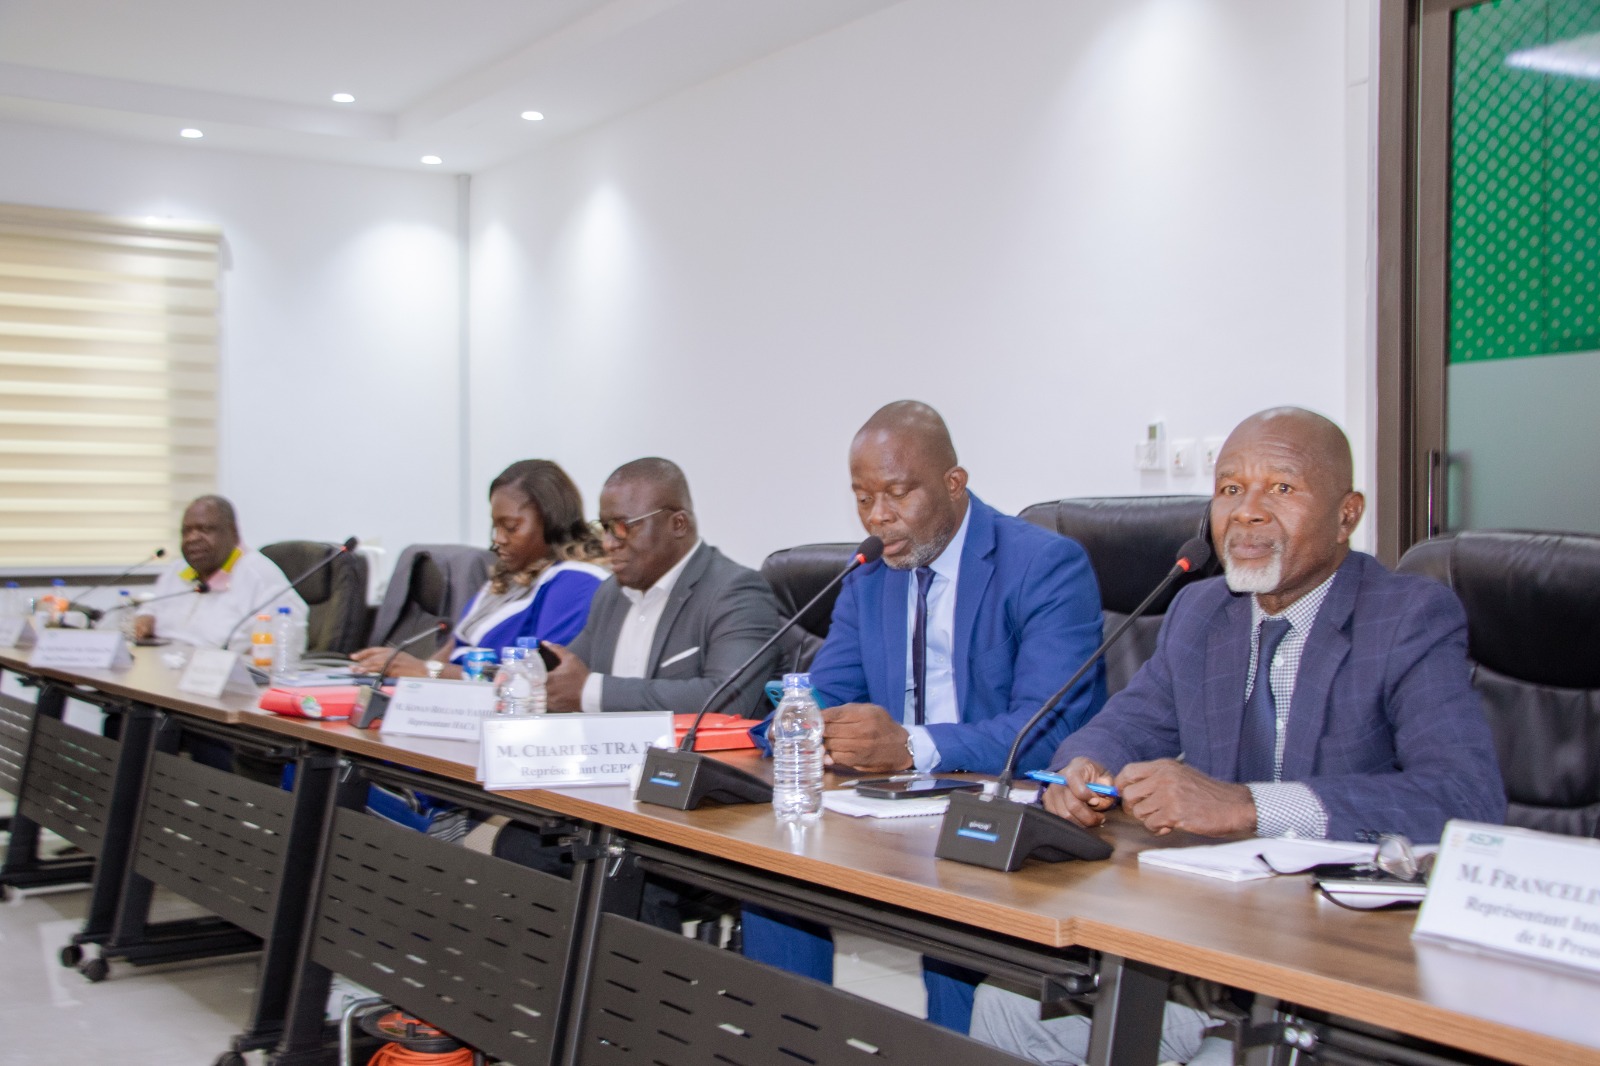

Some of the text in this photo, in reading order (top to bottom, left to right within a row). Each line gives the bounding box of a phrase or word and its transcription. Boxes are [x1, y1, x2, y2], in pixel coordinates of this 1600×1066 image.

[496, 745, 518, 758] M.
[522, 744, 598, 758] CHARLES
[602, 741, 639, 755] TRA
[521, 764, 597, 779] Représeant
[1457, 863, 1483, 884] M.
[1465, 896, 1570, 927] Représentant
[1515, 929, 1536, 945] de
[1538, 933, 1555, 949] la
